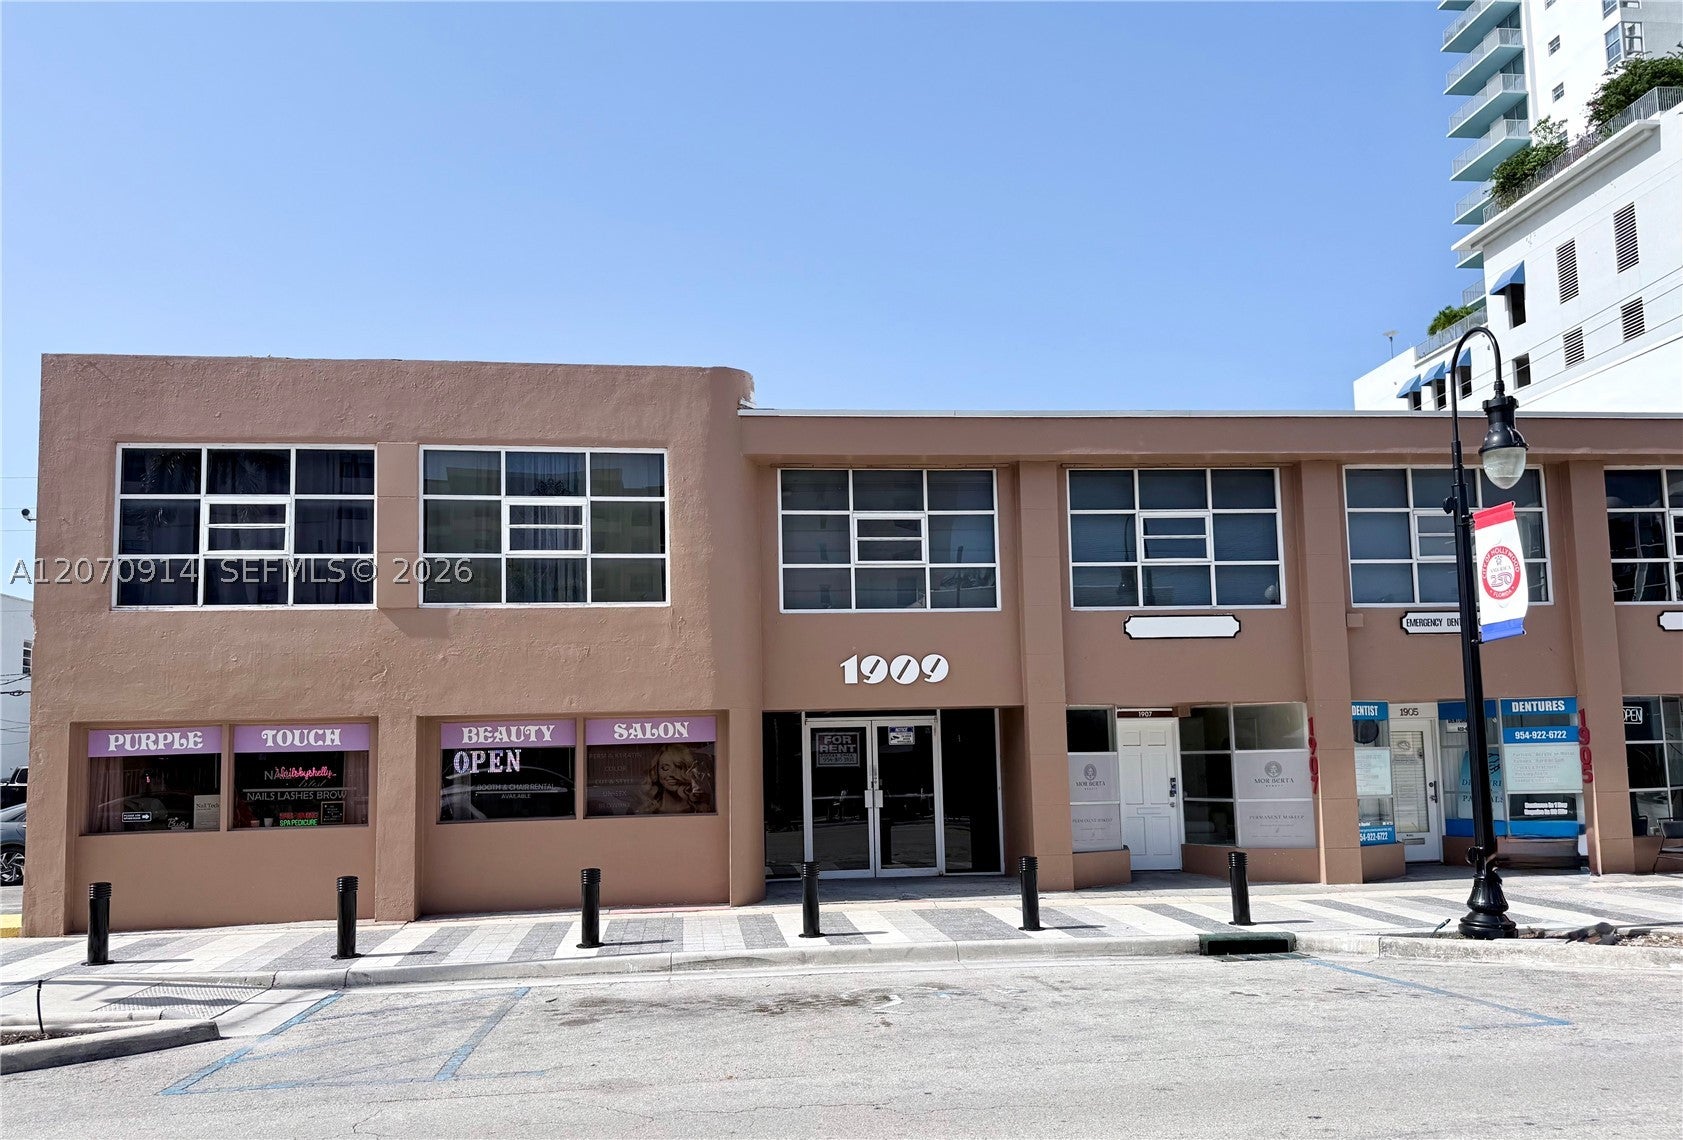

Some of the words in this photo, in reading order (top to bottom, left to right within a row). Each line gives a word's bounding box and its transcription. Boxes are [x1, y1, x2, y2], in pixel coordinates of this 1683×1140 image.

[1490, 547, 1520, 573] HOLLYWOOD
[1406, 618, 1443, 627] EMERGENCY
[839, 653, 950, 685] 1909
[1351, 705, 1379, 716] DENTIST
[1511, 700, 1565, 712] DENTURES
[1399, 707, 1419, 717] 1905
[461, 724, 556, 744] BEAUTY
[613, 721, 690, 740] SALON
[1514, 730, 1567, 740] 954-922-6722
[107, 731, 204, 752] PURPLE
[261, 728, 342, 747] TOUCH
[823, 735, 852, 744] FOR
[820, 744, 856, 753] RENT
[453, 748, 522, 775] OPEN
[530, 783, 555, 791] RENTAL
[246, 792, 275, 801] NAILS
[277, 791, 314, 800] LASHES
[279, 819, 291, 827] SPA
[291, 818, 318, 826] PEDICURE
